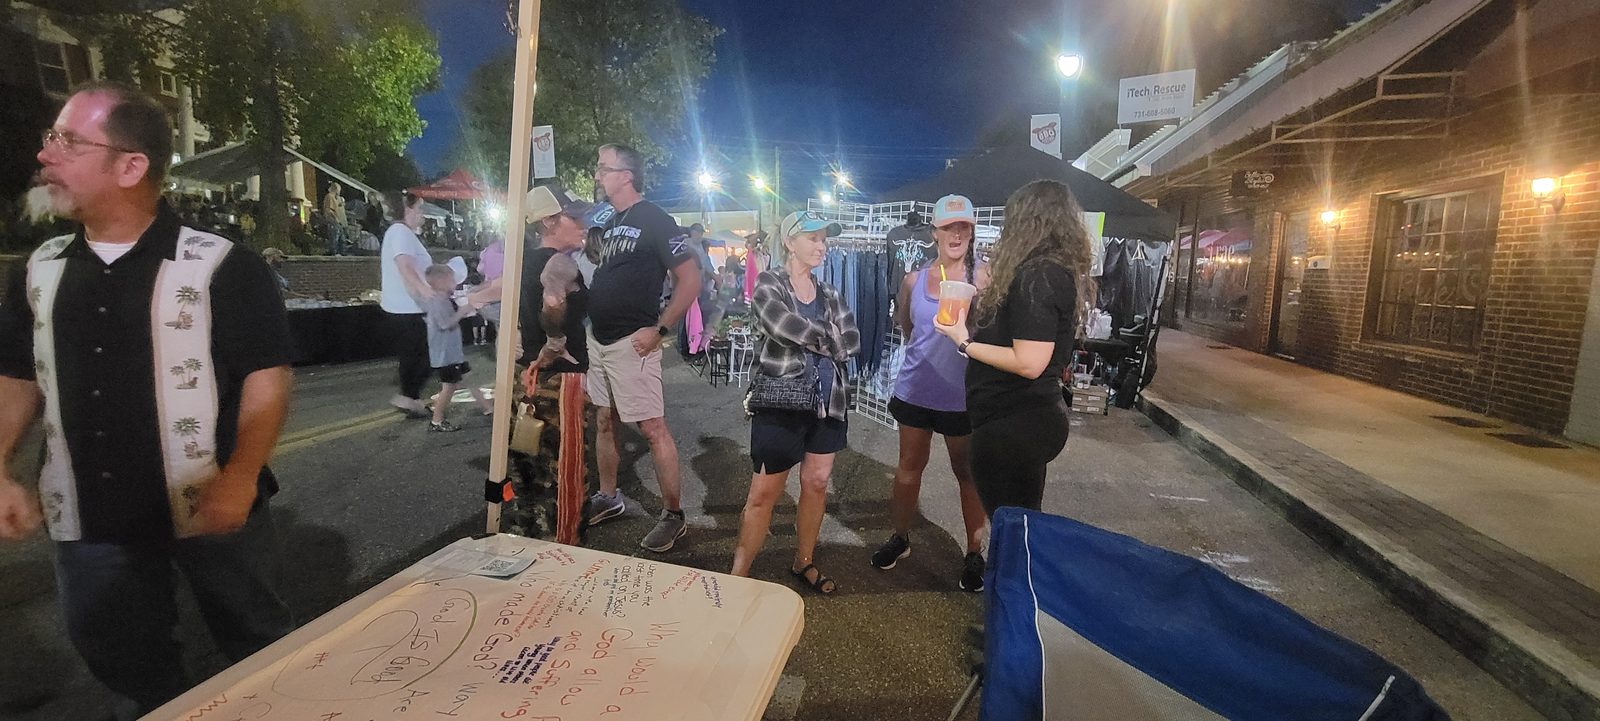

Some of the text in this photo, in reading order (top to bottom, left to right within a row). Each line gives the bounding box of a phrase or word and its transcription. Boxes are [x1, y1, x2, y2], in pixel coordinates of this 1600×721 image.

[1127, 84, 1187, 98] iTech Rescue
[520, 570, 556, 588] Who
[430, 597, 471, 624] God
[494, 592, 527, 627] made
[563, 629, 582, 653] and
[591, 627, 634, 660] God
[622, 621, 681, 650] Why
[466, 632, 514, 670] God?
[370, 656, 431, 684] Good
[560, 667, 603, 706] allow
[392, 689, 432, 713] Are
[600, 704, 621, 716] a
